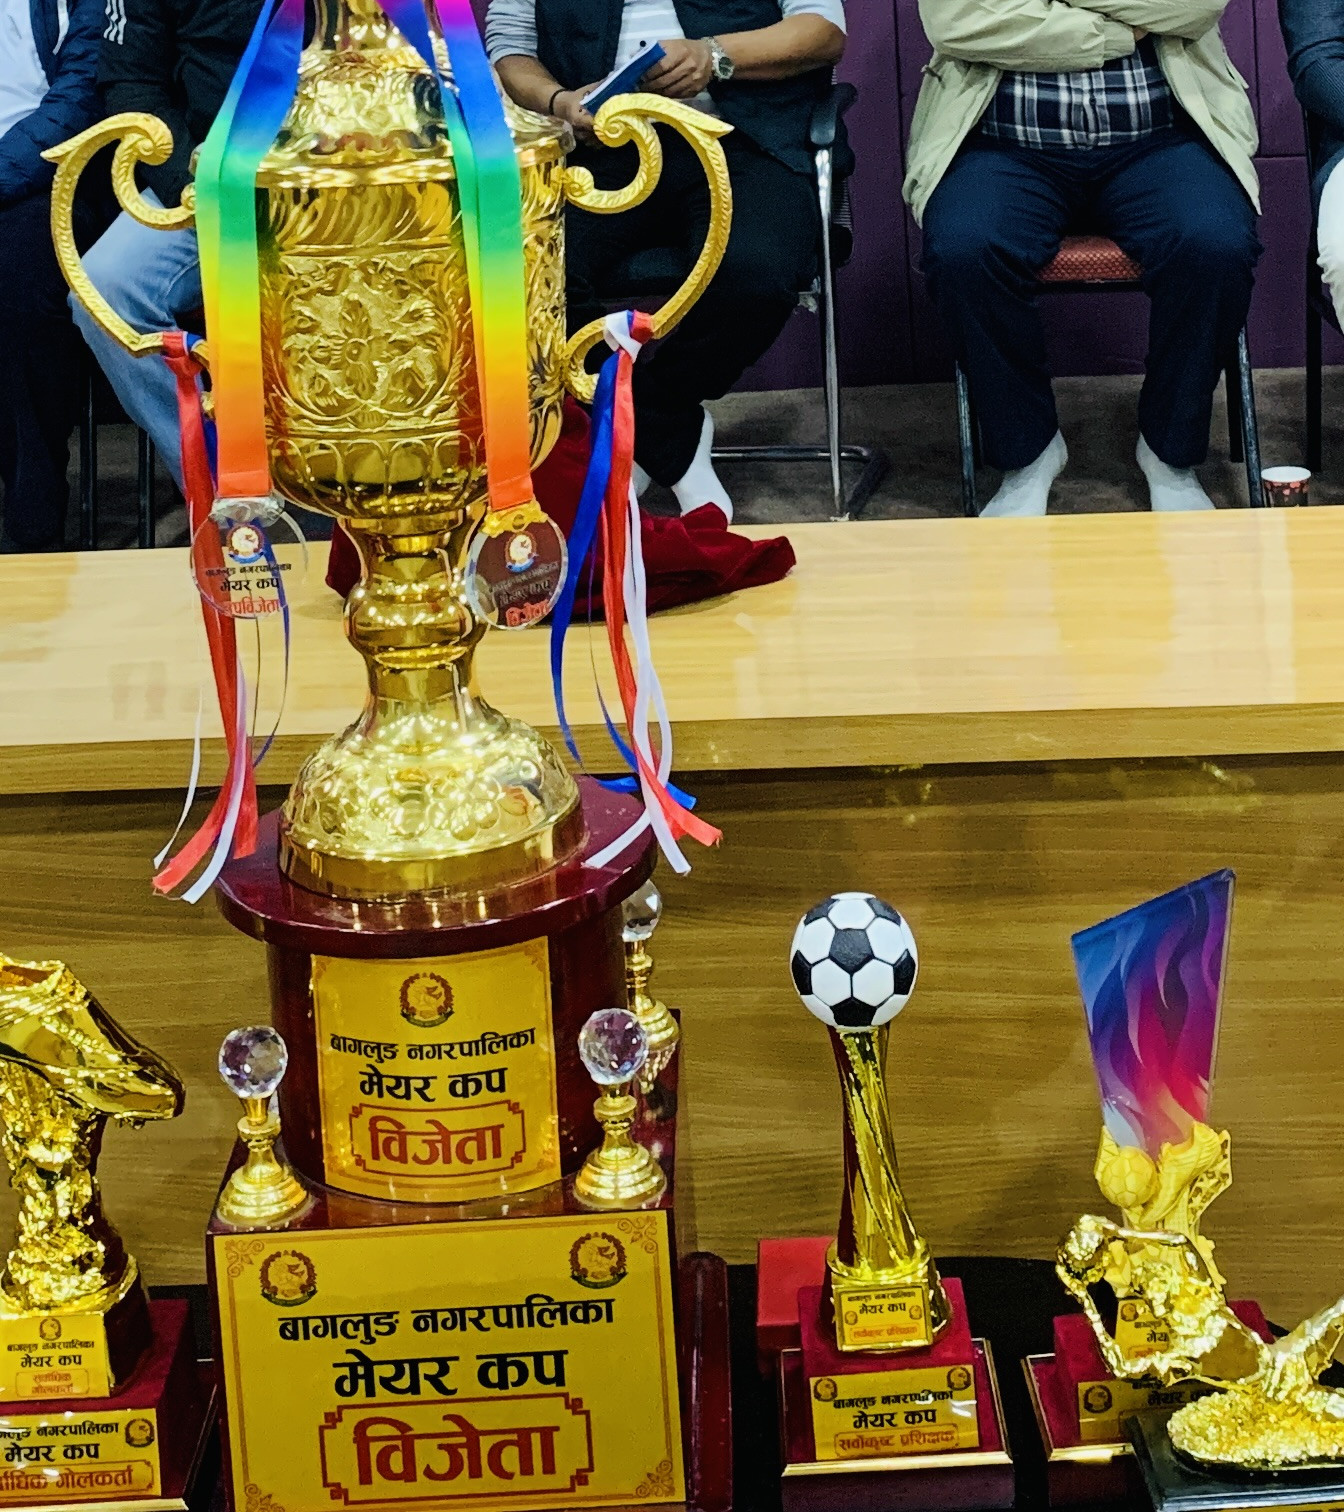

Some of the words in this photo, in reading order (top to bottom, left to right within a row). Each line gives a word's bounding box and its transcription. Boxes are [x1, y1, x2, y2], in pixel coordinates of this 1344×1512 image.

[220, 578, 252, 591] मेयर
[256, 577, 280, 589] कप
[329, 1033, 400, 1063] बागलुङ
[406, 1027, 536, 1060] नगरपालिका
[359, 1064, 438, 1102] मेयर
[448, 1067, 508, 1099] कप
[368, 1115, 505, 1166] विजेता
[859, 1303, 884, 1314] मेयर
[887, 1302, 906, 1312] कप
[278, 1310, 400, 1345] बागलुङ
[412, 1293, 616, 1333] नगरपालिका
[1146, 1330, 1169, 1343] मेय
[20, 1353, 54, 1368] मेयर
[58, 1354, 82, 1366] कप
[332, 1348, 460, 1398] मेयर
[476, 1349, 569, 1390] कप
[833, 1396, 877, 1410] बागलुङ
[36, 1420, 120, 1437] नगरपालिका
[852, 1410, 898, 1429] मेयर
[903, 1409, 937, 1425] कप
[4, 1441, 56, 1463] मेयर
[63, 1442, 101, 1459] कप
[353, 1414, 561, 1486] विजेता
